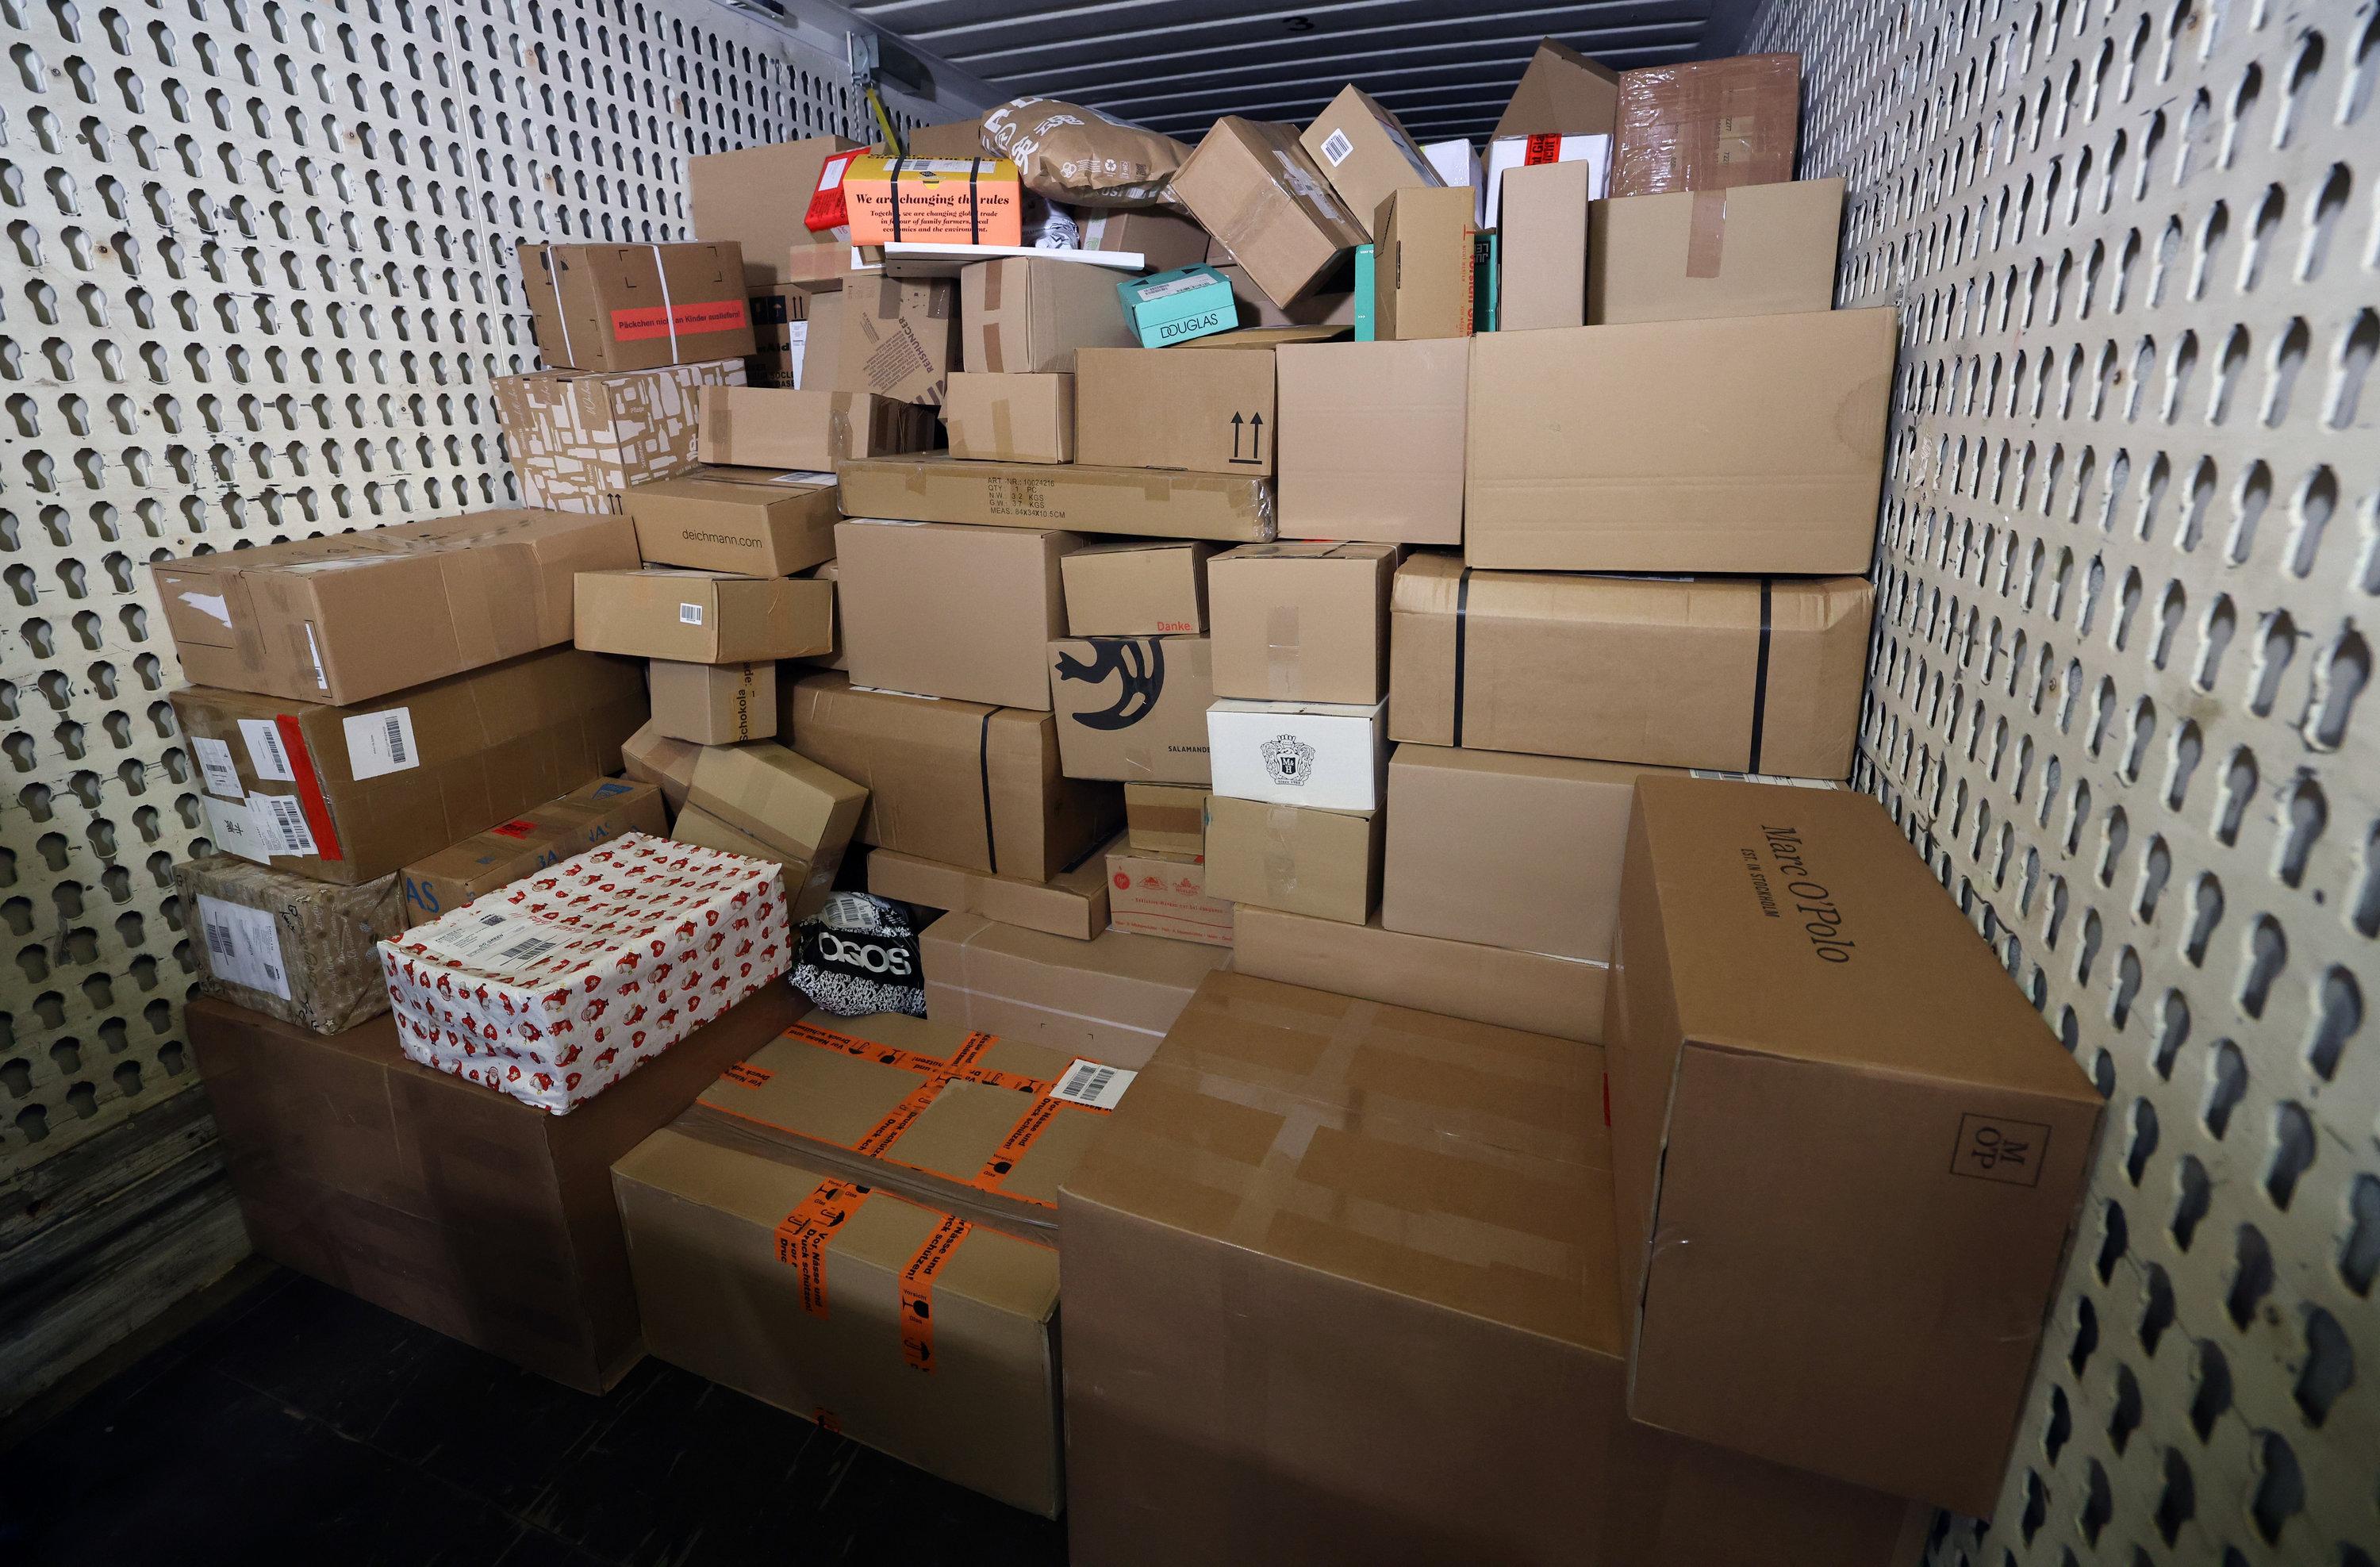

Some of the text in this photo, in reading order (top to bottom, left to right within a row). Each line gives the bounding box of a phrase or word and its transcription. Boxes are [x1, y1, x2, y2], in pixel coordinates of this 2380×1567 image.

[856, 194, 872, 204] We
[900, 194, 954, 206] changing
[958, 194, 971, 205] th
[980, 195, 1009, 205] rules
[618, 319, 655, 330] Päckchen
[1160, 313, 1219, 339] DOUGLAS
[681, 529, 762, 548] deichmann.com
[1157, 621, 1193, 632] Danke.
[1168, 745, 1211, 754] SALAMANDE
[1750, 873, 1780, 918] STOCKHOLM
[1761, 825, 1856, 963] Marc O'Polo
[818, 931, 912, 976] asos
[965, 1051, 978, 1065] und
[746, 1069, 771, 1081] Druck
[1031, 1097, 1051, 1117] Druck
[1046, 1100, 1061, 1112] Vor
[871, 1119, 896, 1138] Druck
[896, 1111, 918, 1131] Druck
[1018, 1133, 1032, 1147] und
[813, 1198, 827, 1207] Glas
[845, 1190, 858, 1199] Glas
[800, 1228, 818, 1258] Druck
[923, 1226, 965, 1275] Nässe und
[904, 1233, 943, 1281] schützen!
[811, 1232, 830, 1308] Vor Nässe und
[902, 1288, 927, 1300] Vorsicht
